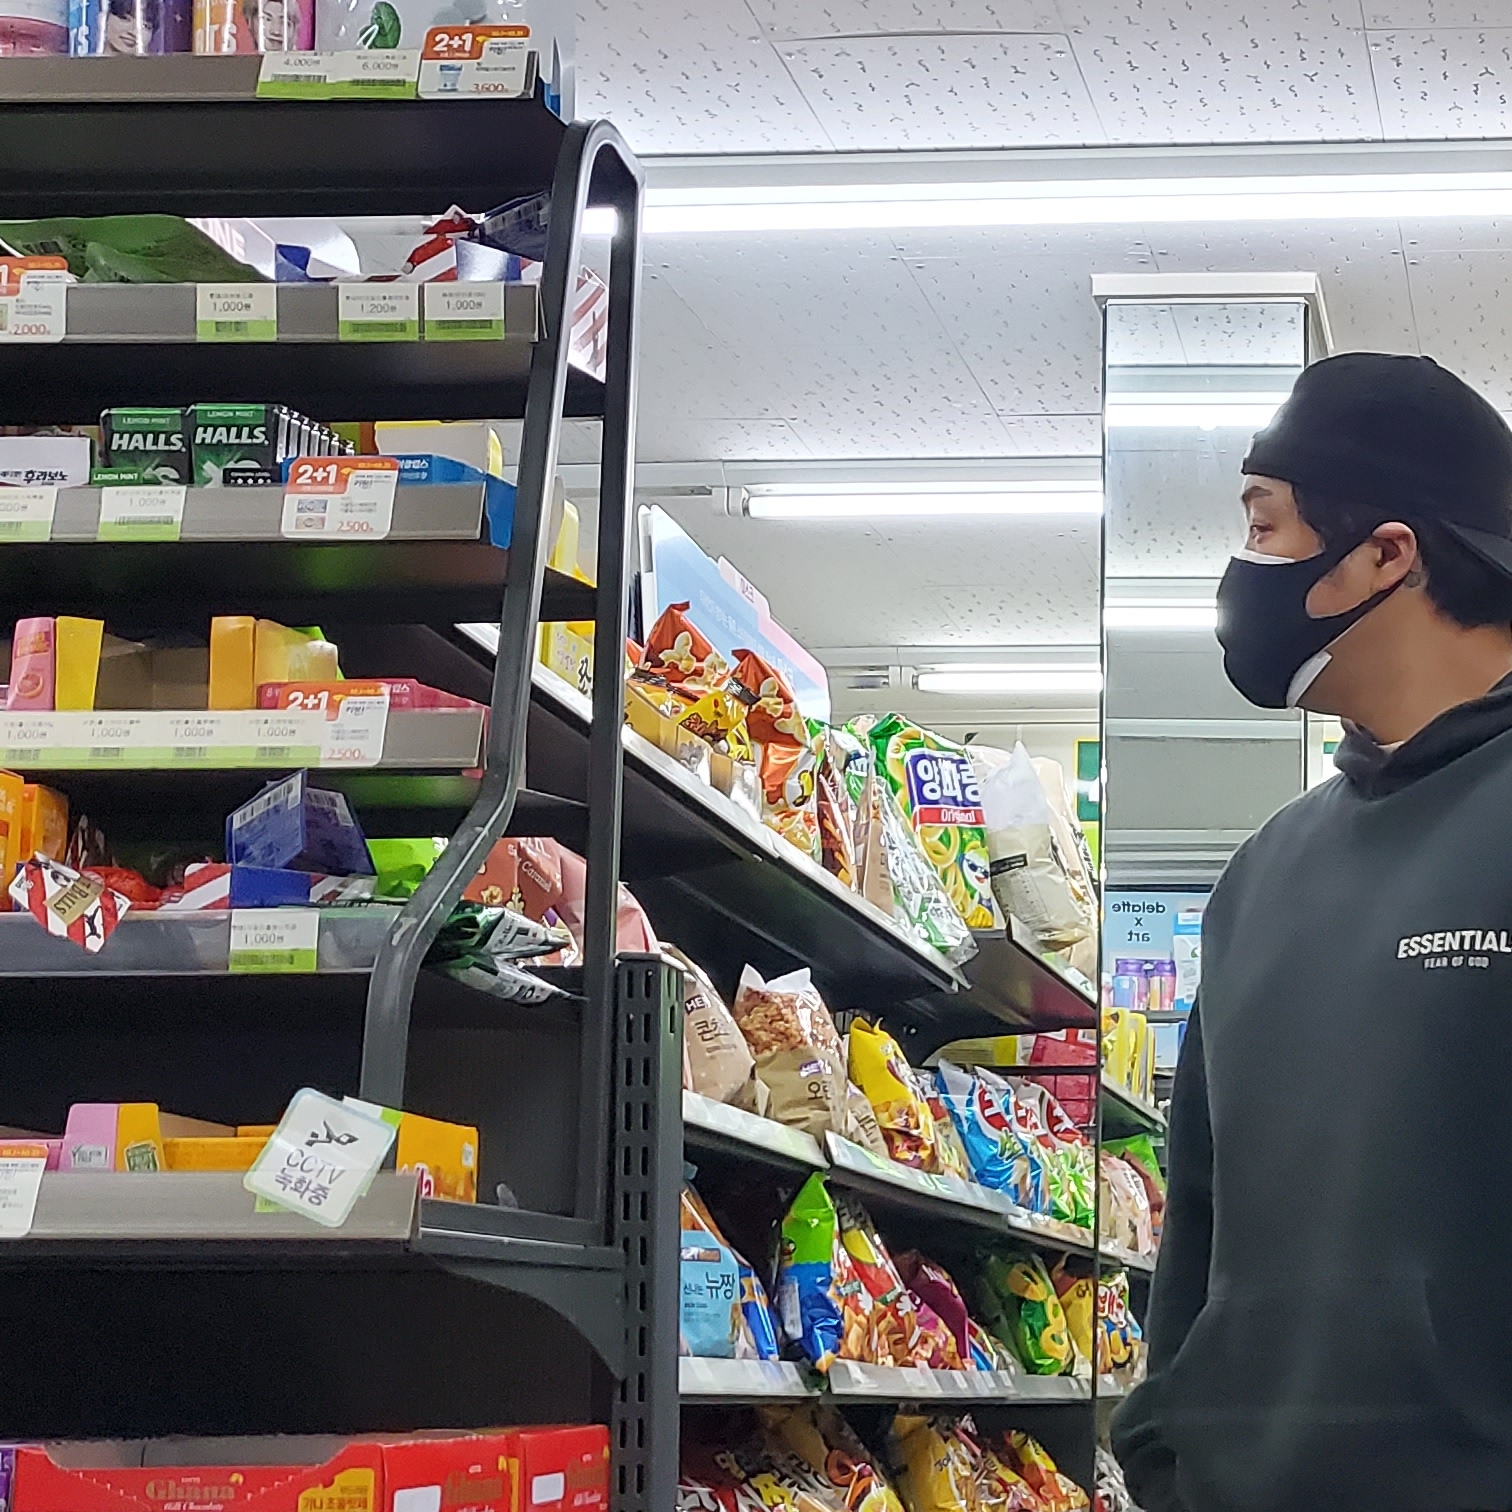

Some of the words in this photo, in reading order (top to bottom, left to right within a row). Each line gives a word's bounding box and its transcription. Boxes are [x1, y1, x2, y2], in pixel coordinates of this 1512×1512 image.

[433, 33, 473, 51] 2+1
[111, 433, 184, 451] HALLS
[195, 426, 266, 444] HALLS
[23, 470, 69, 484] 후라보노
[296, 464, 338, 485] 2+1
[286, 690, 329, 711] 2+1
[1423, 957, 1449, 970] FEAR
[1451, 956, 1465, 968] OF
[1468, 956, 1490, 969] GOD
[286, 1148, 346, 1185] CCTV
[274, 1166, 331, 1206] 녹화중
[146, 1479, 237, 1501] Ghana
